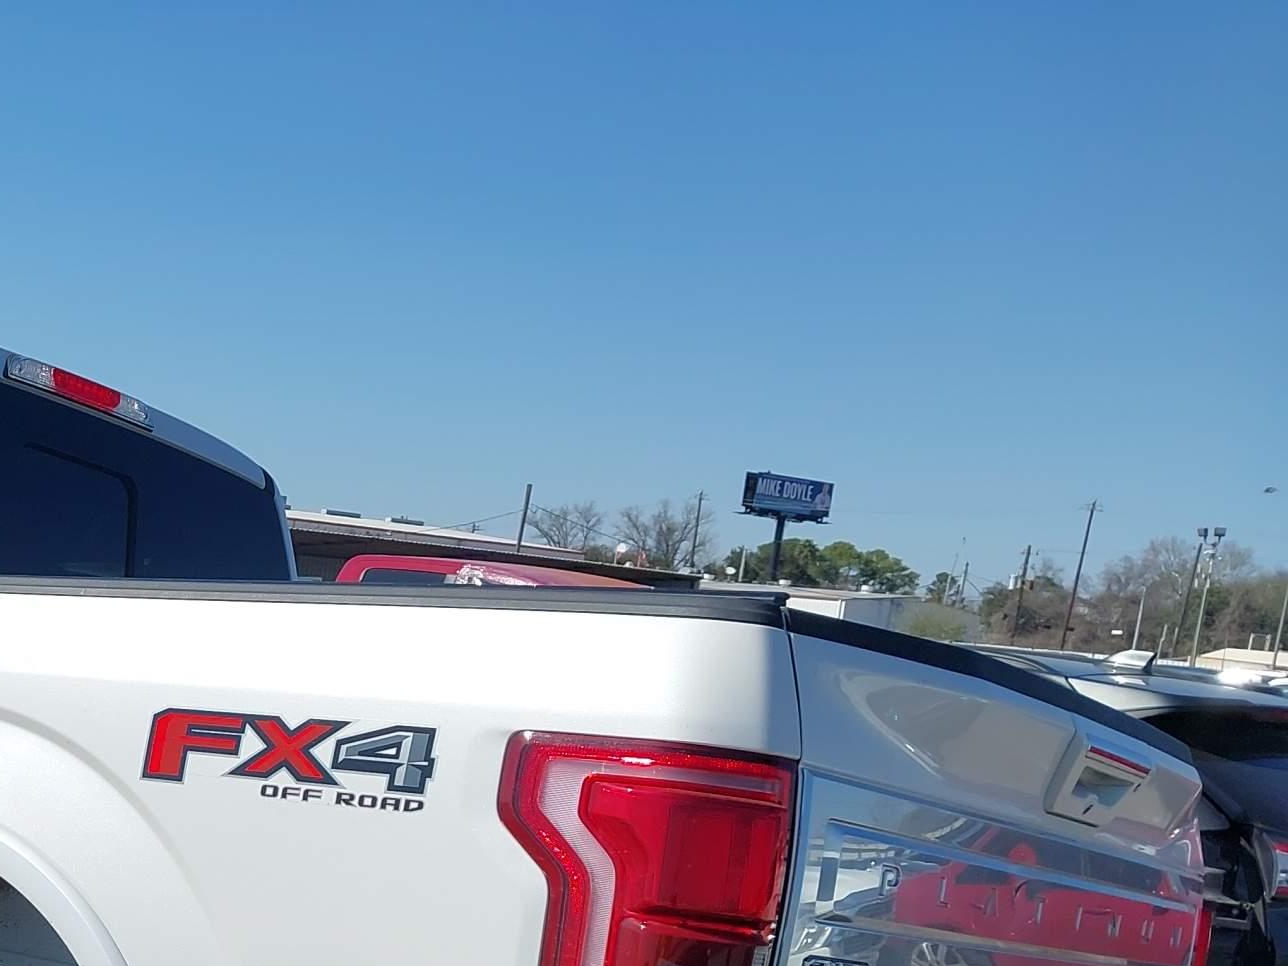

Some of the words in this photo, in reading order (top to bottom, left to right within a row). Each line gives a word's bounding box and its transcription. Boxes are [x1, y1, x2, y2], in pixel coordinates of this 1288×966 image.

[756, 477, 781, 497] MIKE
[783, 482, 815, 502] DOYLE
[141, 707, 438, 795] FX4
[260, 784, 322, 802] OFF
[335, 791, 424, 813] ROAD
